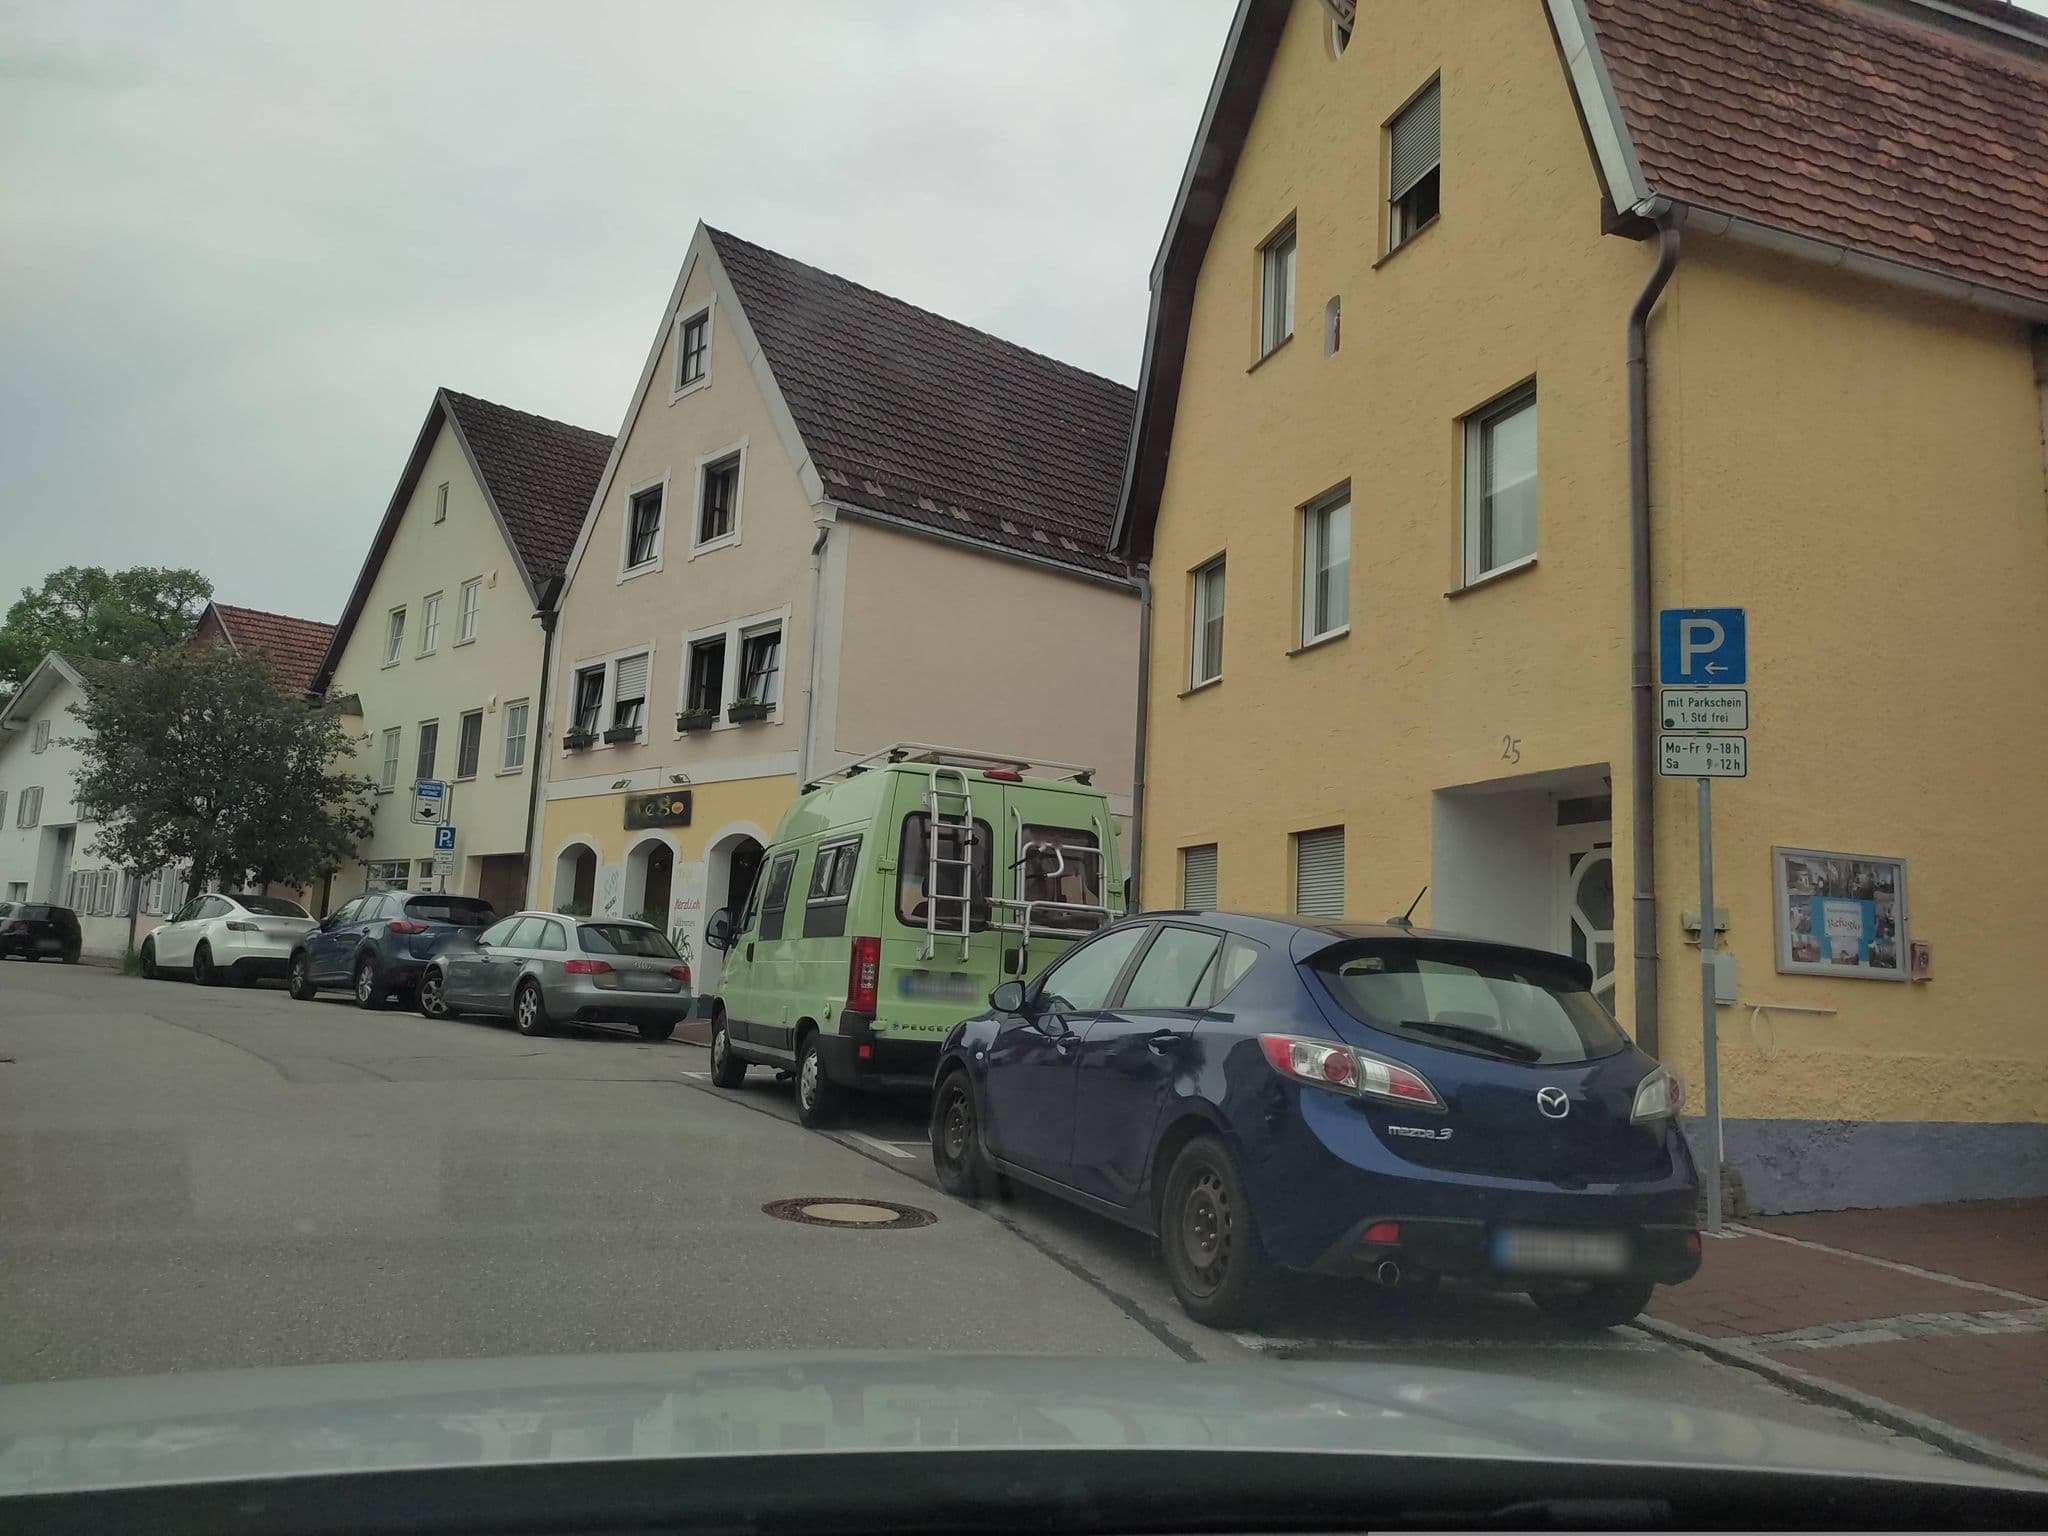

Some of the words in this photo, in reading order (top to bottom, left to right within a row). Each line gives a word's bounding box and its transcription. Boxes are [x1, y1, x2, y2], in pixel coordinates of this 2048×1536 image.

[1680, 618, 1725, 675] P
[1667, 697, 1683, 708] mit
[1688, 696, 1742, 708] Parkschein
[1681, 712, 1688, 723] 1.
[1691, 712, 1707, 723] Std
[1711, 712, 1728, 723] frei
[1501, 735, 1521, 764] 25
[1665, 742, 1700, 754] Mo-Fr
[1666, 758, 1679, 769] Sa
[439, 829, 452, 847] P
